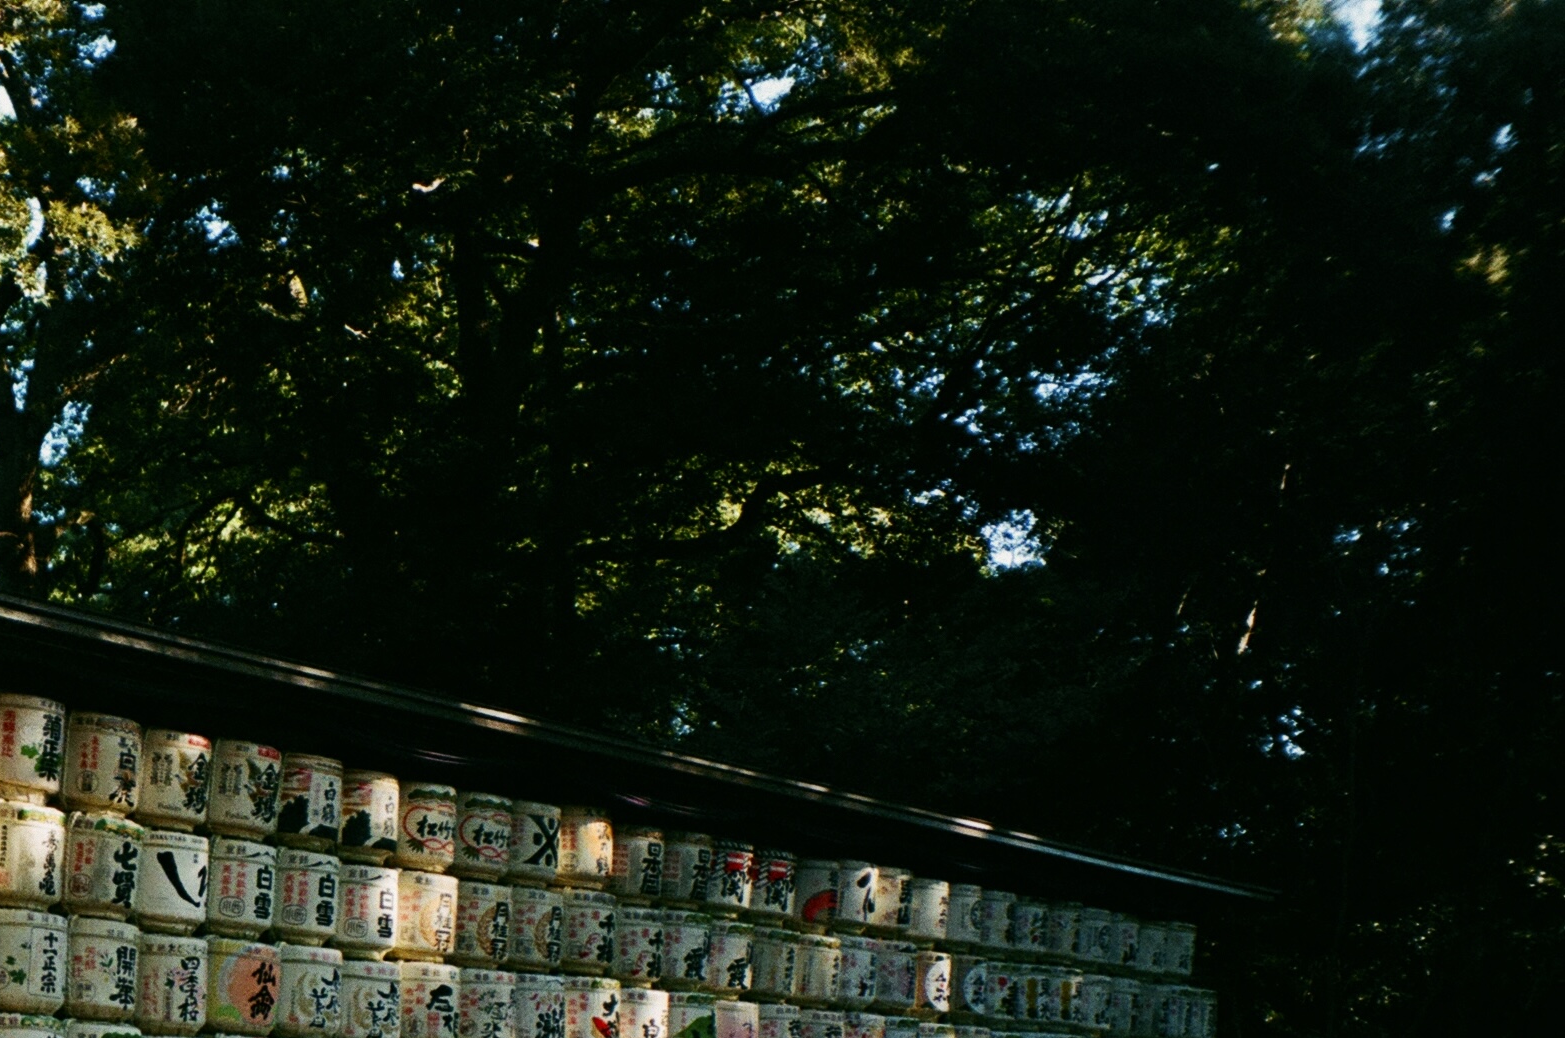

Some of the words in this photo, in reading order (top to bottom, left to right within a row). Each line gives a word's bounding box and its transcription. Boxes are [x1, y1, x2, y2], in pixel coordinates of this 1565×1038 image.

[40, 931, 60, 994] 十一正宗
[178, 955, 201, 1022] 四季桜
[247, 960, 277, 1021] 仙禽
